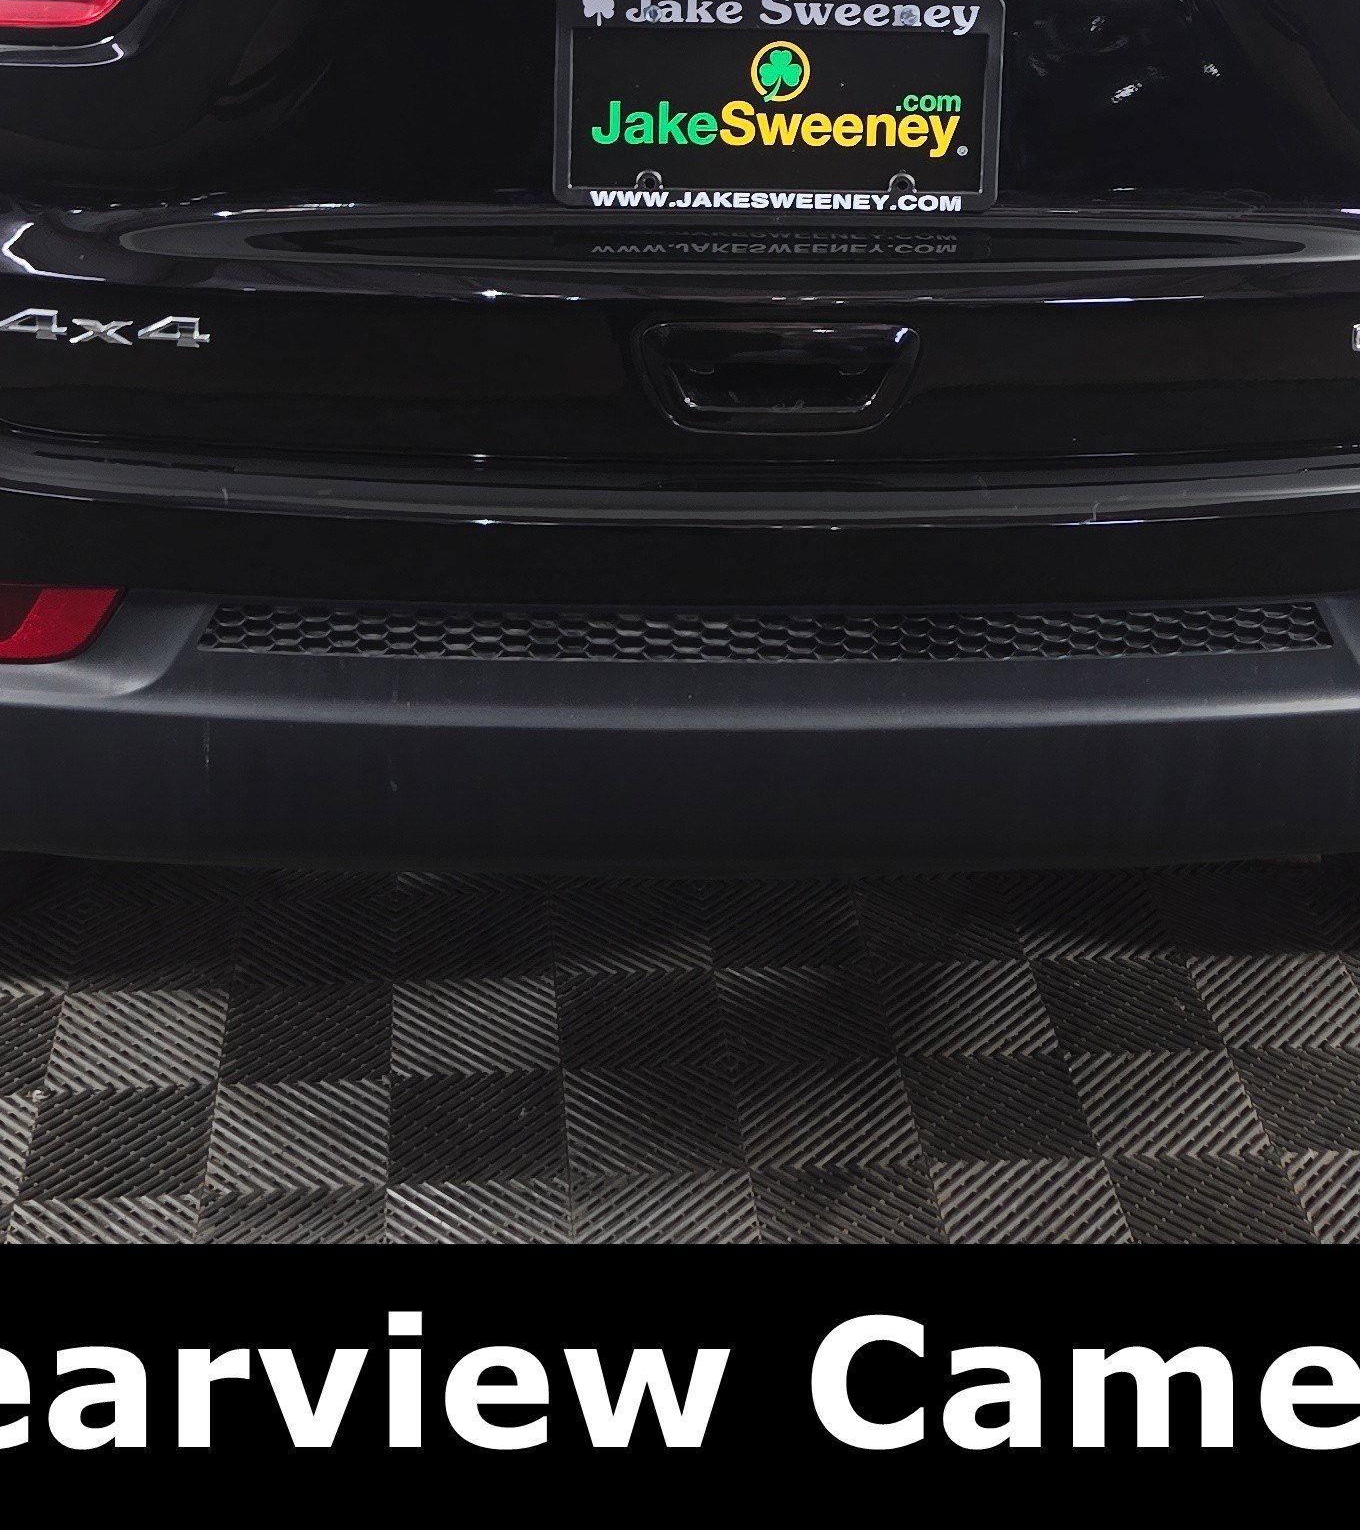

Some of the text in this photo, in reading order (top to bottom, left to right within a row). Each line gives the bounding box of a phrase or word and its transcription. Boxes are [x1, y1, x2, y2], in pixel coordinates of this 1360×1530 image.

[895, 93, 962, 113] .com
[591, 100, 961, 158] JakeSweeney
[590, 189, 962, 213] WWW.JAKESWEENEY.COM
